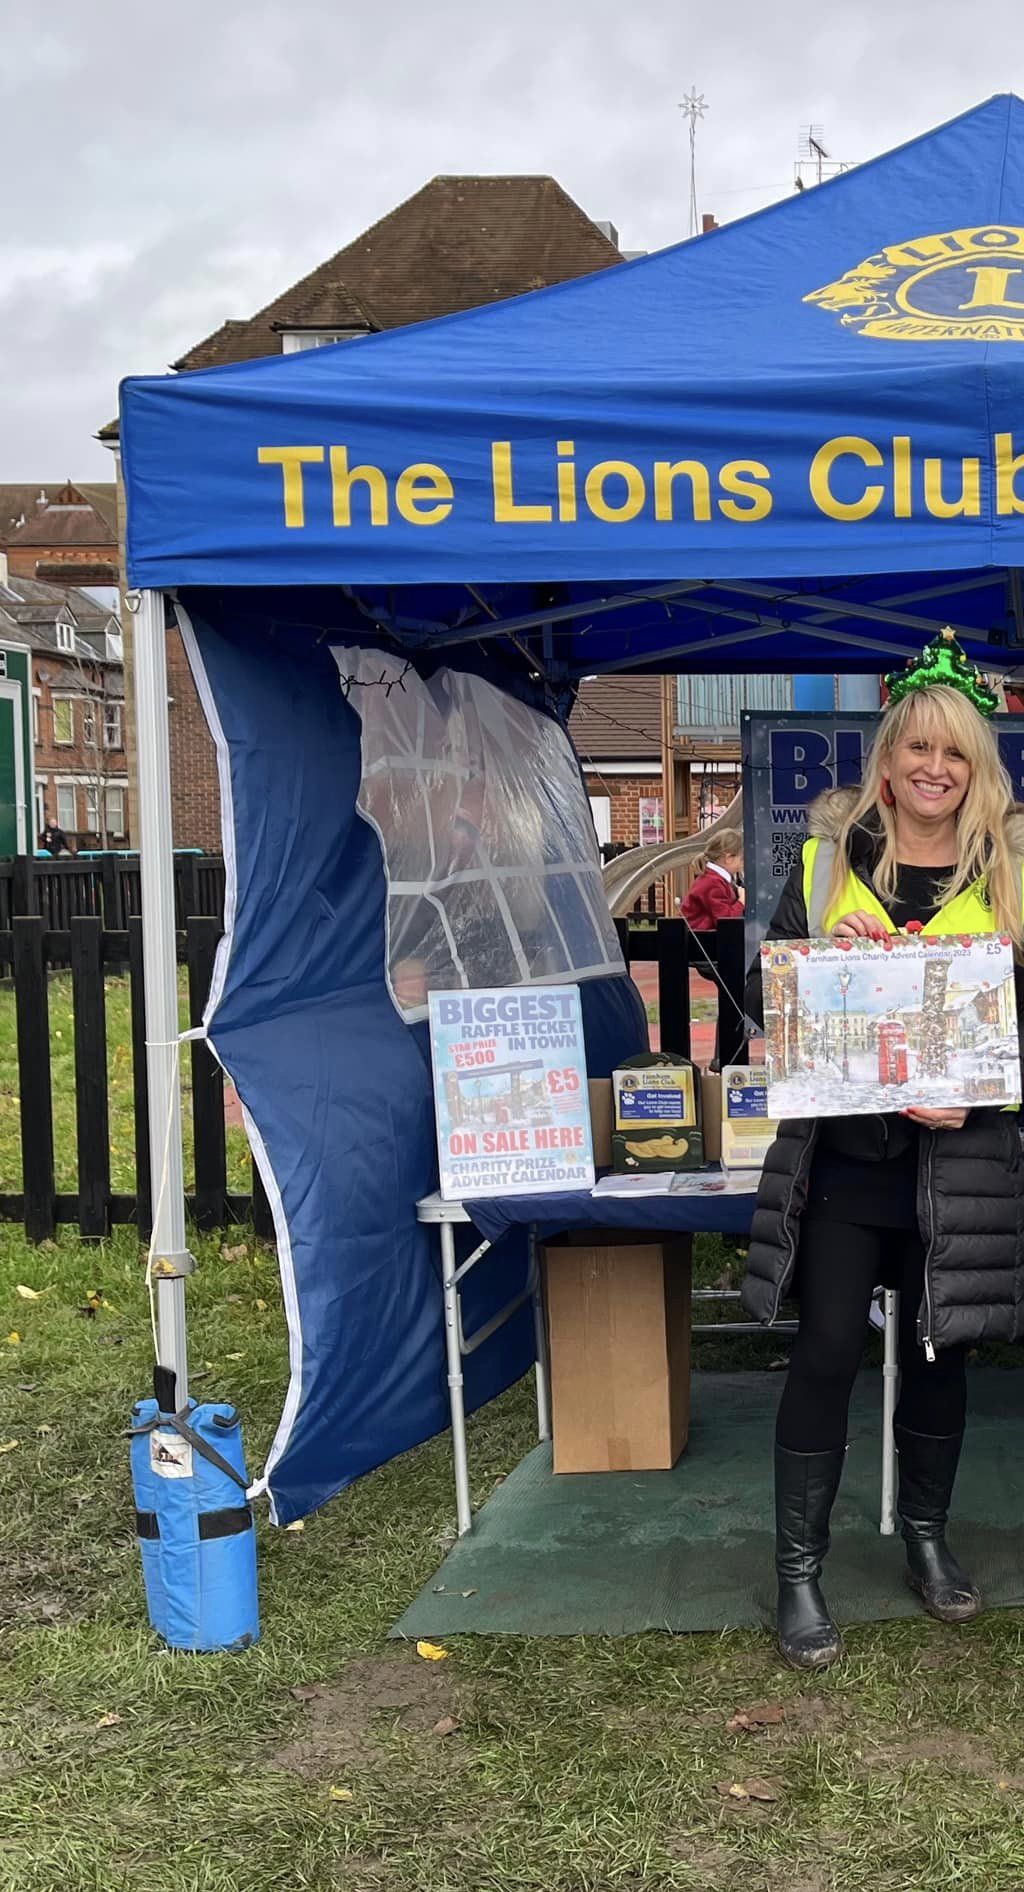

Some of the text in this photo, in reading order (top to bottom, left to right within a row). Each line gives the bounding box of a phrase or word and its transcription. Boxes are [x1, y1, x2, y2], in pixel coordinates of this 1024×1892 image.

[257, 445, 454, 527] The
[491, 440, 773, 523] Lions
[890, 950, 917, 960] Advent
[986, 942, 1002, 955] £5
[440, 994, 575, 1025] BIGGEST
[461, 1020, 577, 1039] RAFFLE TICKET
[508, 1034, 578, 1050] IN TOWN
[455, 1049, 496, 1068] £500
[547, 1067, 581, 1095] £5
[449, 1126, 584, 1156] ON SALE HERE
[451, 1157, 557, 1175] CHARITY PRIZE
[451, 1166, 587, 1188] ADVENT CALENDAR
